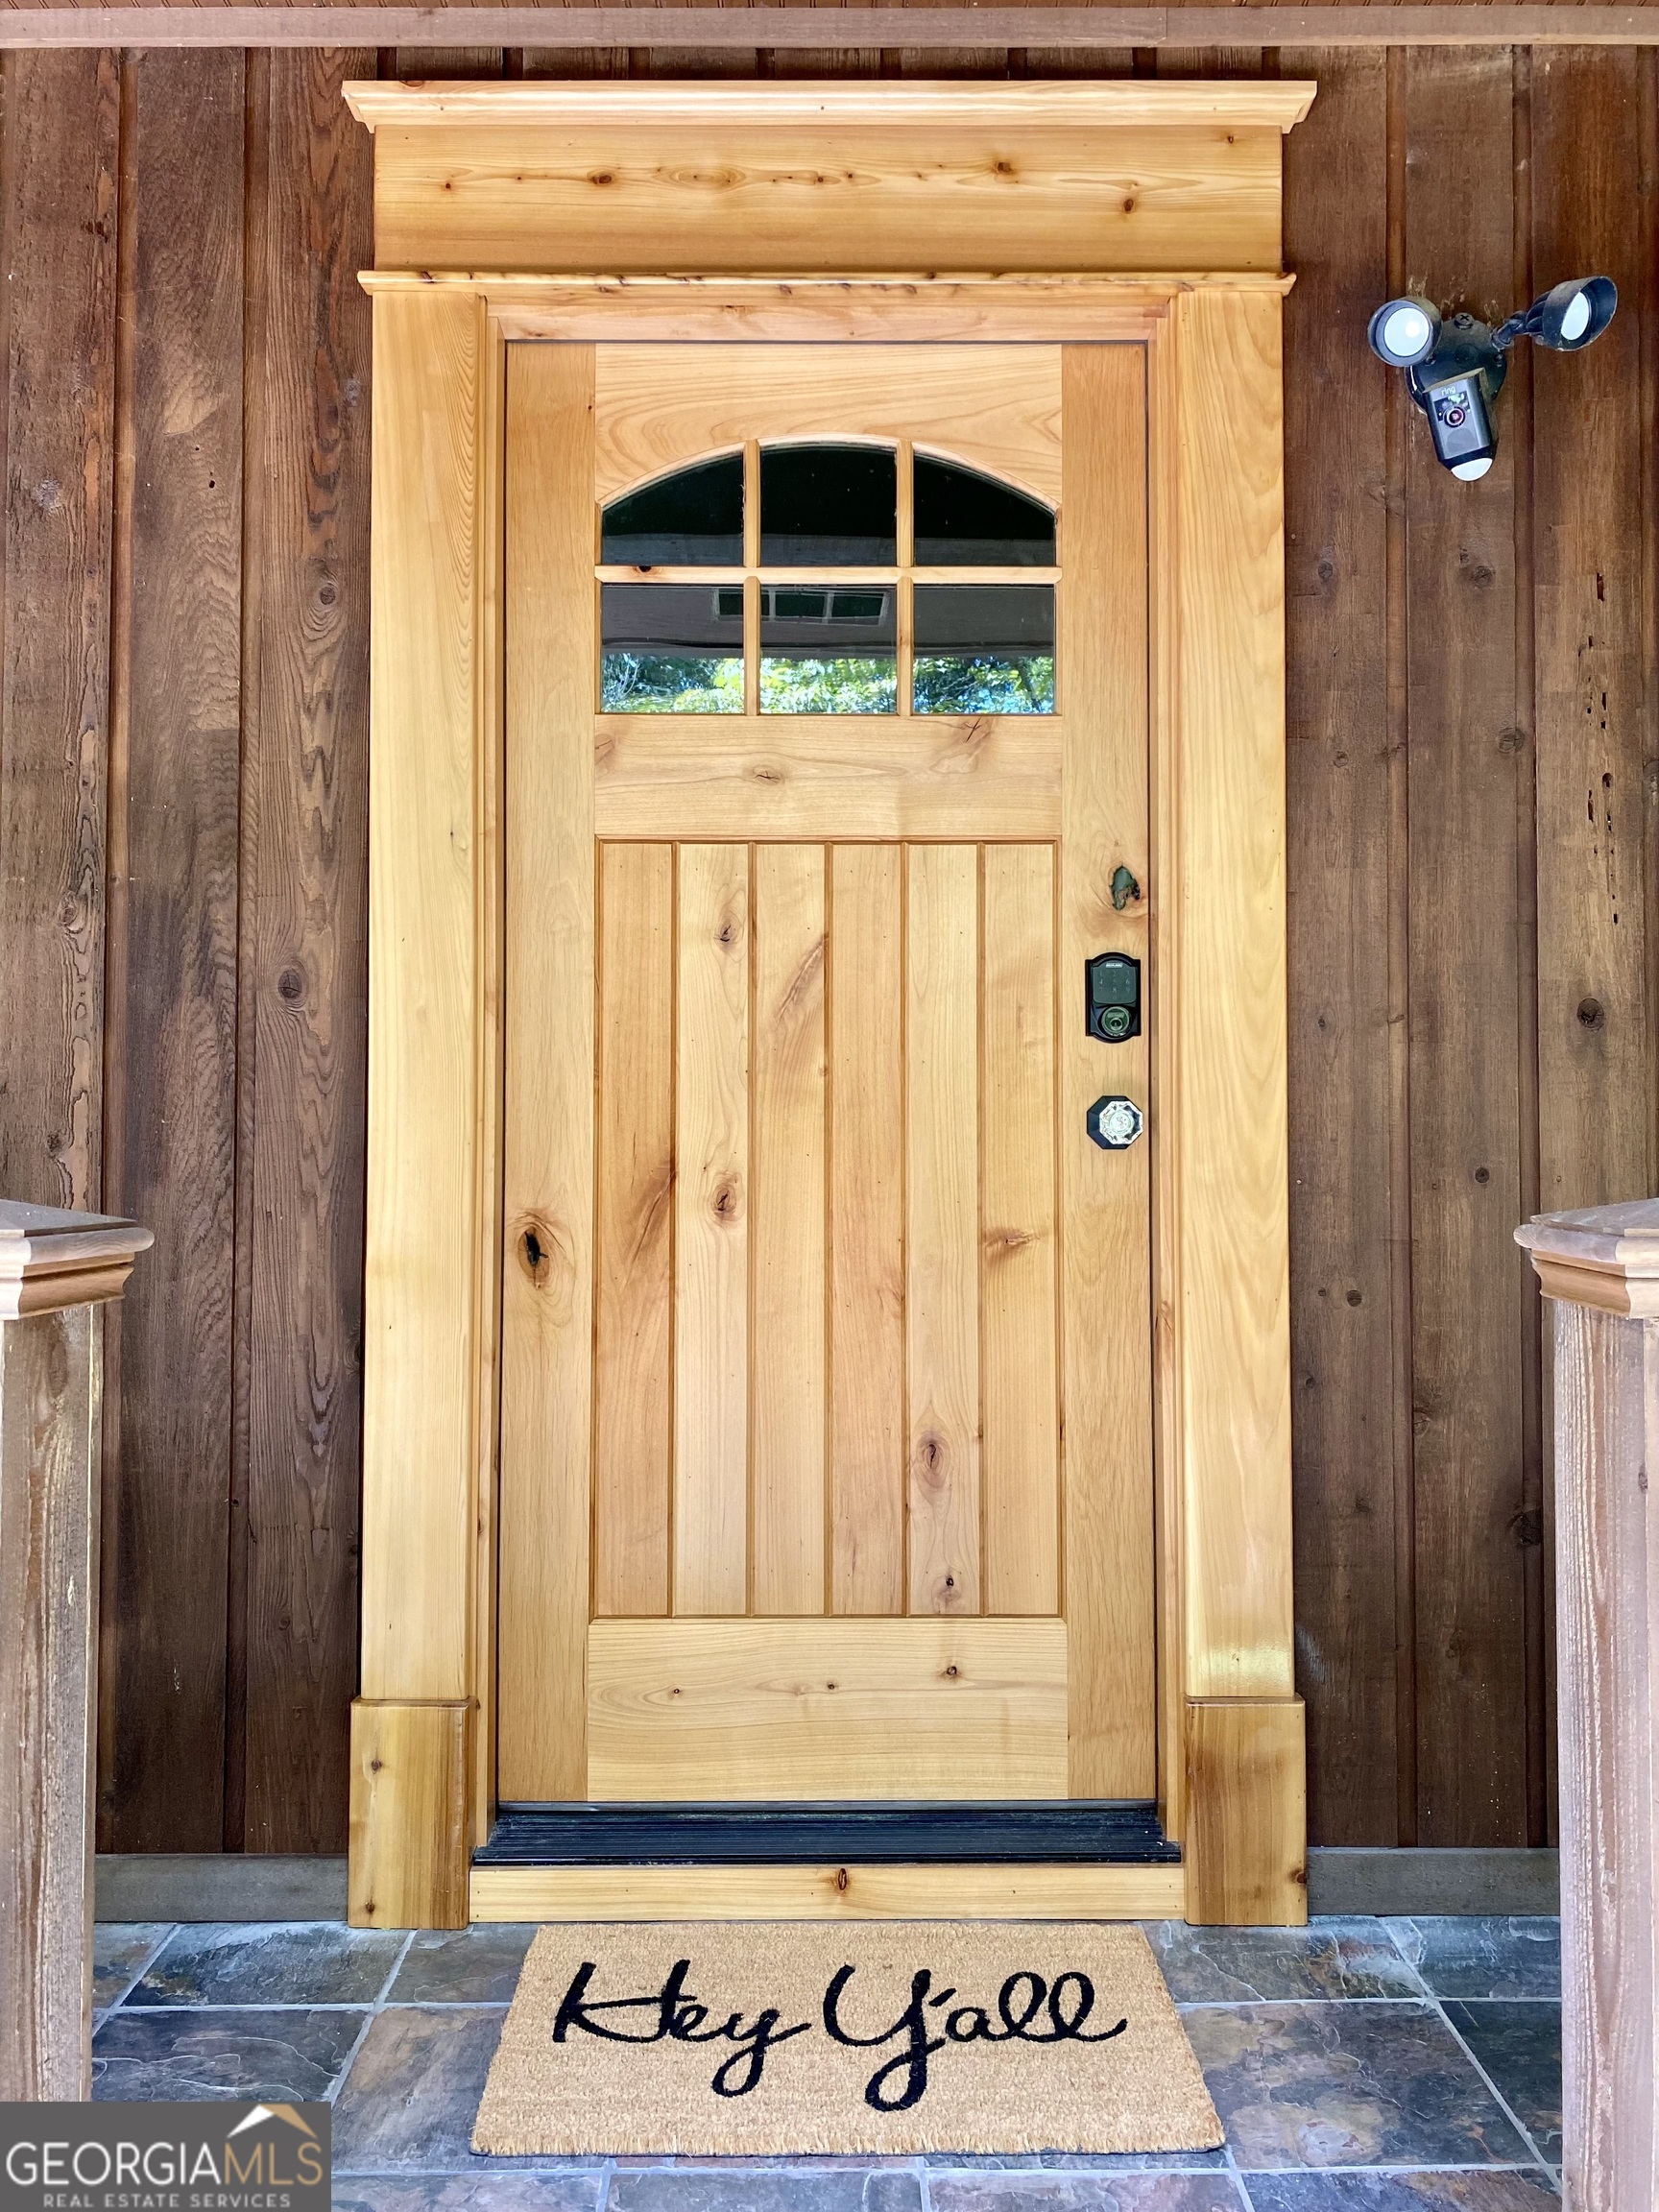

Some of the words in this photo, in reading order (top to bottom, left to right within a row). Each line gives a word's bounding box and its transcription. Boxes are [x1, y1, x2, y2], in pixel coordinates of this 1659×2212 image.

[1441, 386, 1456, 397] ring
[551, 1959, 812, 2098] Hey
[822, 1963, 1128, 2113] Y'all
